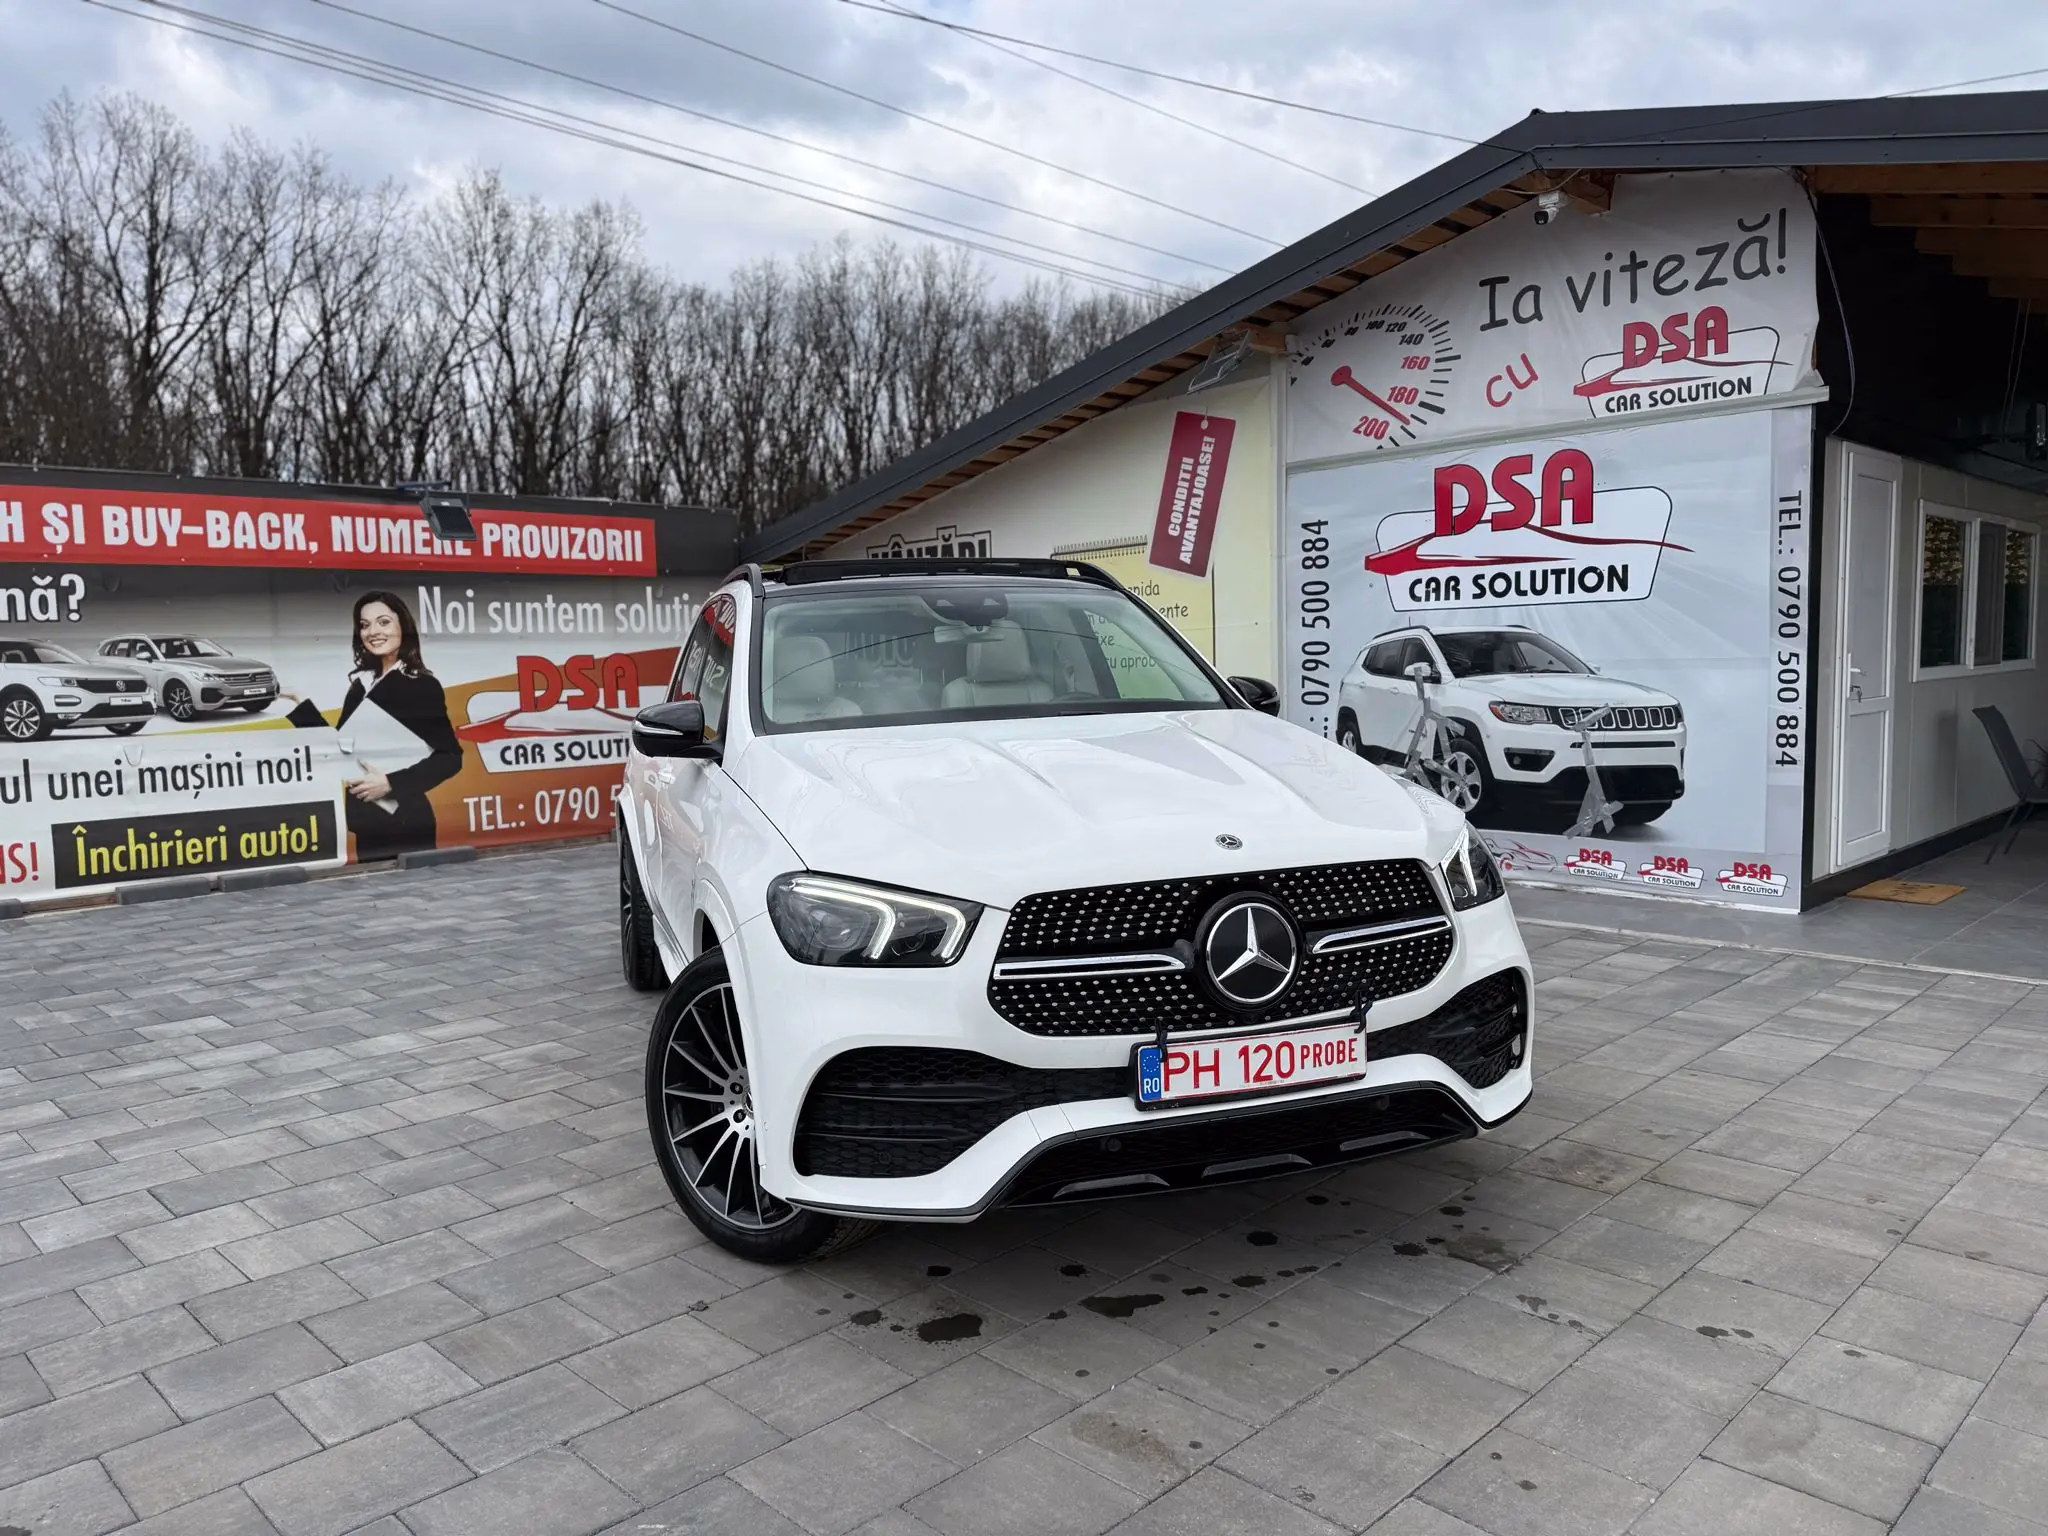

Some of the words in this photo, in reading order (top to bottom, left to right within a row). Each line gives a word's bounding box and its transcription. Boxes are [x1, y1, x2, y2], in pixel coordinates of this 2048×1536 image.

[1479, 274, 1543, 332] Ia
[1565, 207, 1787, 314] viteză!
[1385, 321, 1408, 333] 120
[1398, 333, 1425, 345] 140
[1622, 305, 1729, 369] DSA
[1400, 356, 1430, 370] 160
[1485, 353, 1540, 408] cu
[1386, 385, 1419, 405] 180
[1605, 392, 1641, 413] CAR
[1648, 376, 1752, 408] SOLUTION
[1352, 415, 1390, 440] 200
[1168, 457, 1194, 537] CONDITII
[1179, 435, 1215, 565] AVANTAJOASE!
[1434, 448, 1595, 537] DSA
[41, 502, 86, 554] ȘI
[482, 522, 643, 562] PROVIZORII
[1301, 519, 1329, 570] 884
[1778, 489, 1801, 555] TEL.:
[1301, 580, 1330, 629] 500
[1408, 574, 1461, 603] CAR
[1471, 564, 1629, 599] SOLUTION
[1777, 566, 1801, 639] 0790
[418, 585, 475, 635] Noi
[487, 594, 604, 634] suntem
[516, 652, 640, 713] DSA
[1301, 640, 1330, 706] 0790
[1776, 650, 1800, 703] 500
[500, 742, 546, 766] CAR
[1775, 714, 1799, 767] 884
[50, 757, 124, 800] unei
[138, 752, 244, 800] mașini
[256, 745, 313, 786] noi!
[535, 785, 600, 825] 0790
[72, 825, 228, 877] Închirieri
[239, 815, 319, 857] auto!
[1579, 848, 1612, 866] DSA
[1653, 855, 1688, 873] DSA
[1733, 862, 1772, 880] DSA
[1573, 868, 1586, 876] CAR
[1587, 870, 1618, 879] SOLUTION
[1647, 876, 1660, 885] CAR
[1662, 878, 1696, 888] SOLUTION
[1727, 884, 1741, 892] CAR
[1742, 885, 1779, 895] SOLUTION
[1143, 1077, 1160, 1094] RO
[1163, 1047, 1220, 1092] PH
[1238, 1040, 1295, 1084] 120
[1300, 1037, 1358, 1070] PROBE
